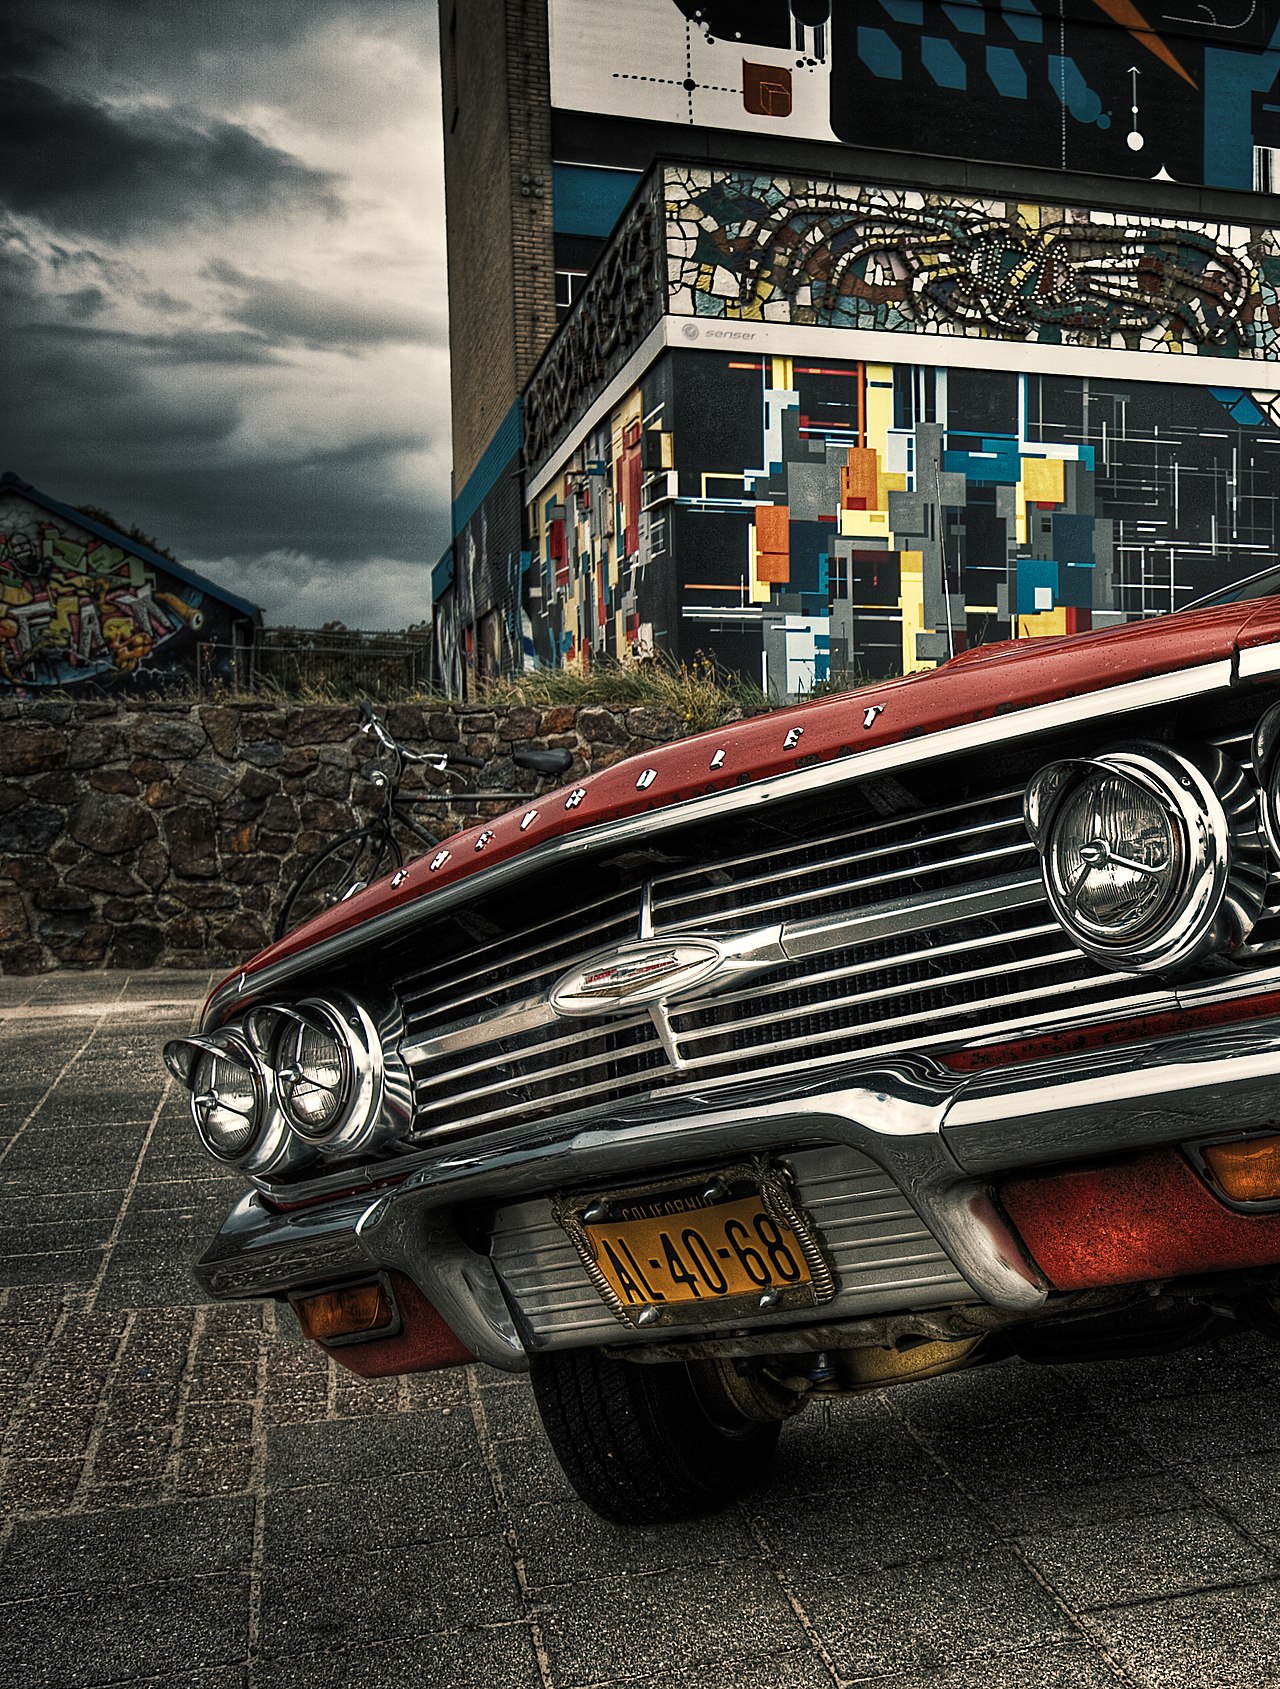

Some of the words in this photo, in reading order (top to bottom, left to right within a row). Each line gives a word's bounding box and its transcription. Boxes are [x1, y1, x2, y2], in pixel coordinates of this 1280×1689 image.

[705, 329, 757, 340] senser
[390, 702, 887, 890] CHEVROLET
[601, 1212, 801, 1304] AL-40-68
